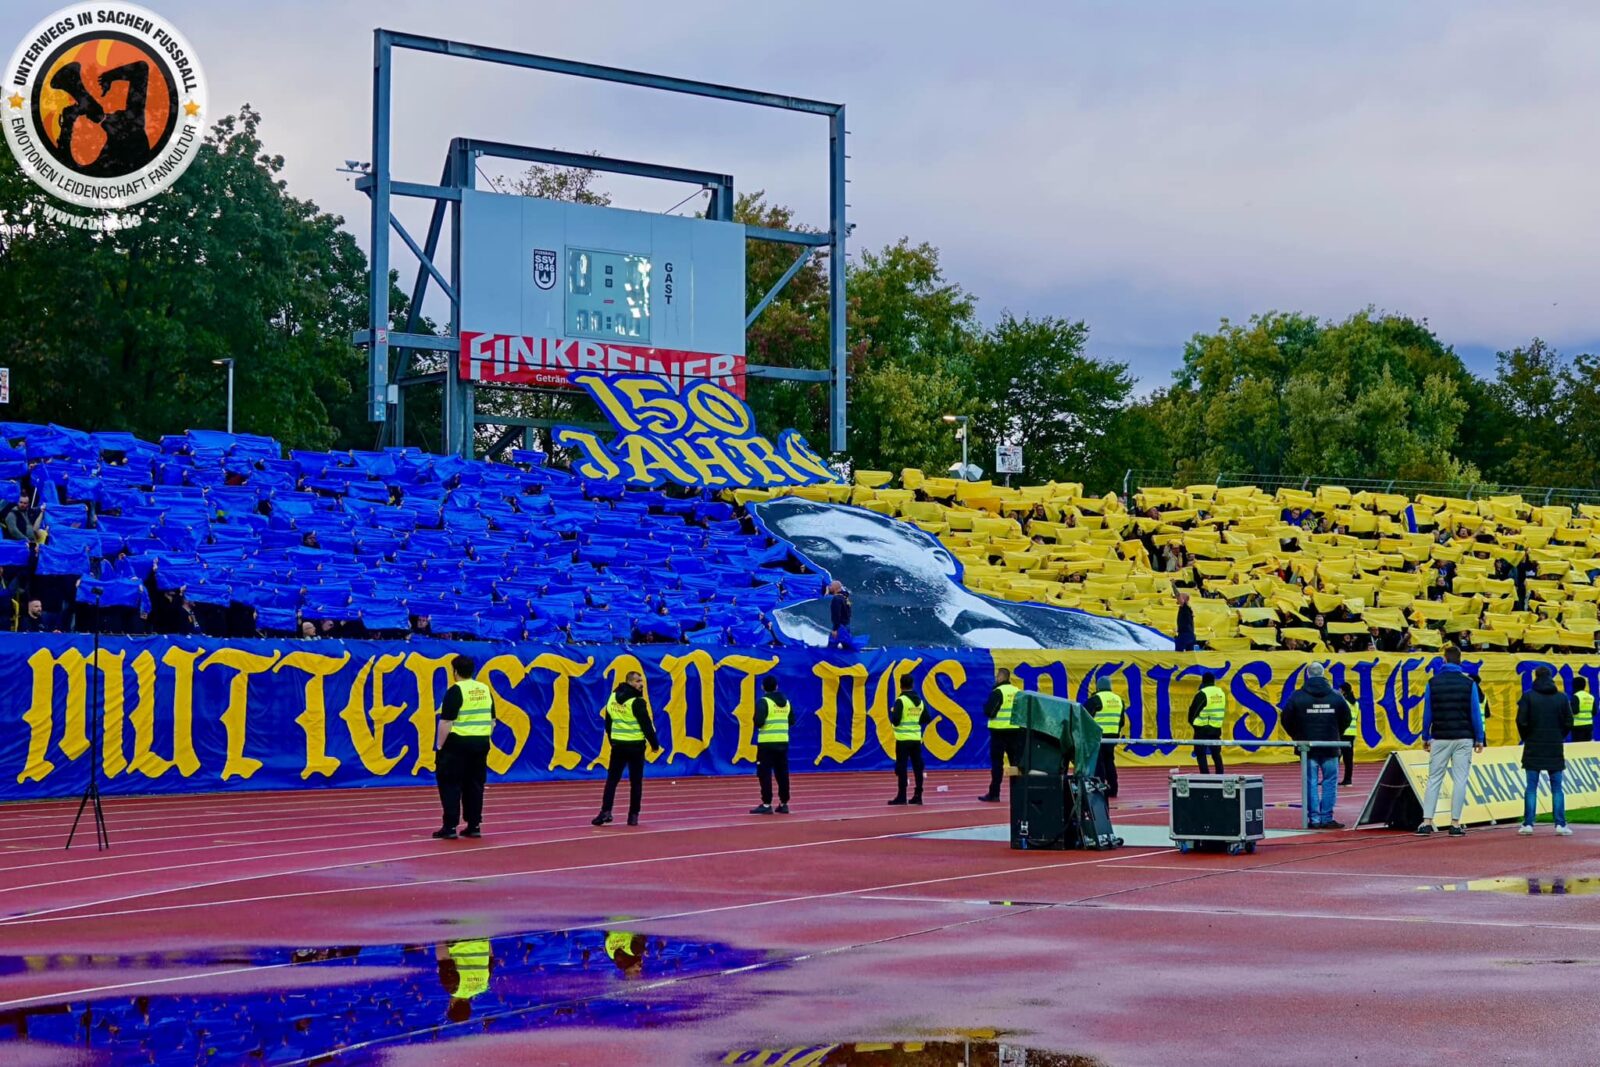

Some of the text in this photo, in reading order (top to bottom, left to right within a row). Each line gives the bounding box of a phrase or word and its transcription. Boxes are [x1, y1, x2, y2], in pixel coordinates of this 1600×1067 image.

[535, 254, 555, 265] SSV
[535, 263, 555, 272] 1846
[664, 262, 673, 305] GAST
[573, 374, 750, 437] 150
